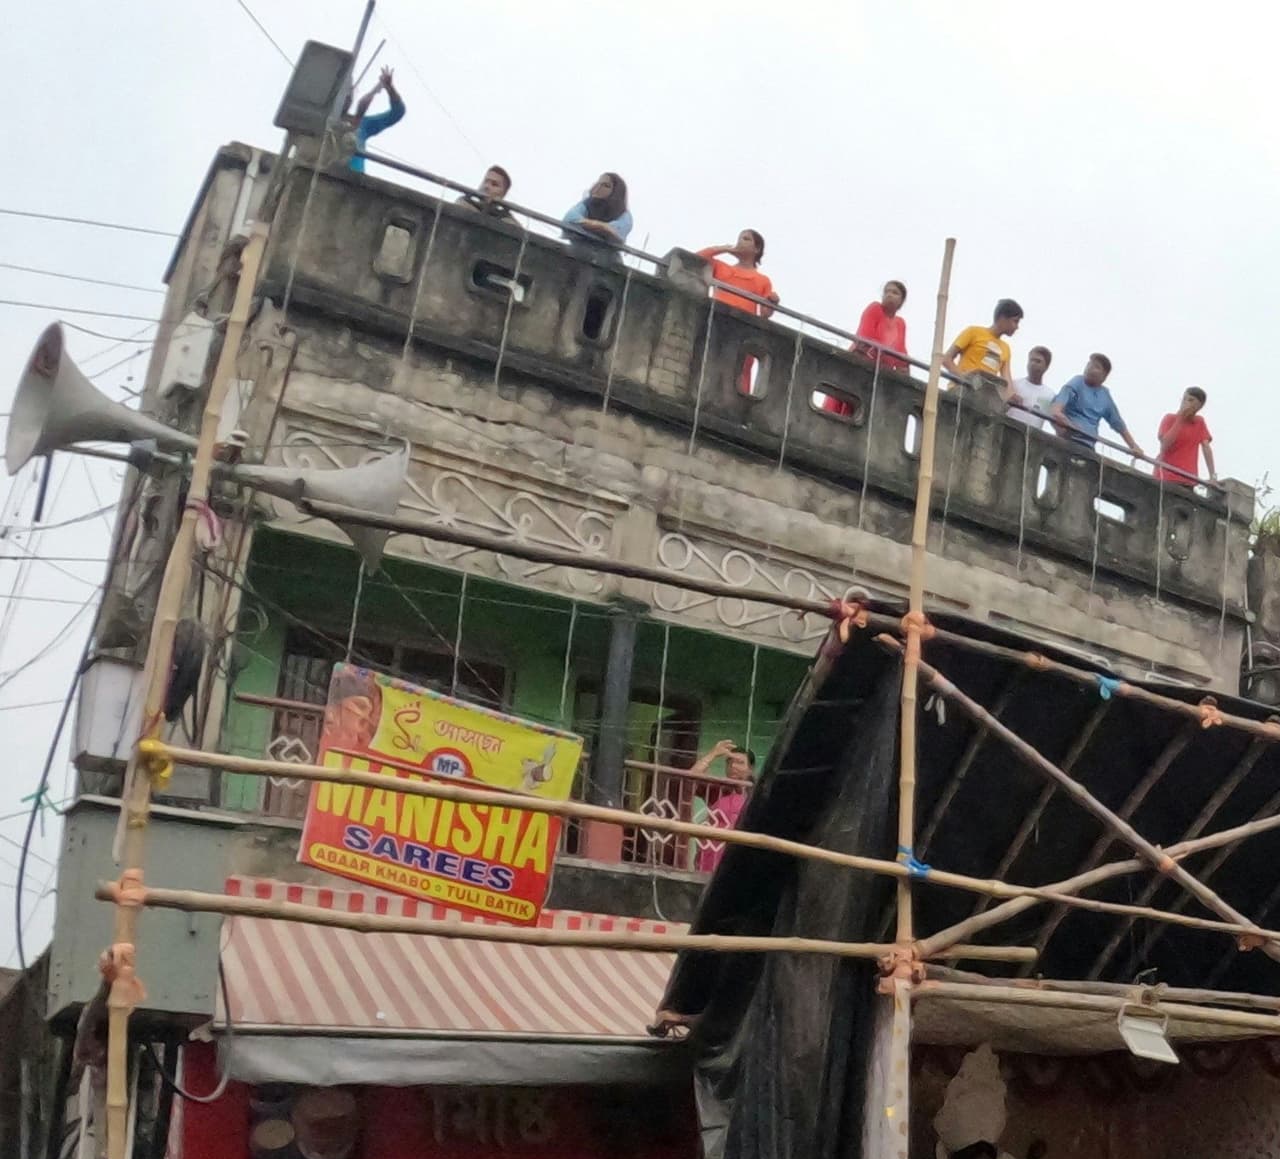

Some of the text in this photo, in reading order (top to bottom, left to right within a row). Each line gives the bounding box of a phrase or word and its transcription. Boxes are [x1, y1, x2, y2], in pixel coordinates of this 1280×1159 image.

[316, 750, 549, 874] MANISHA
[315, 846, 530, 916] ABAAR KHABO TULI BATIK
[342, 824, 515, 892] SAREES
